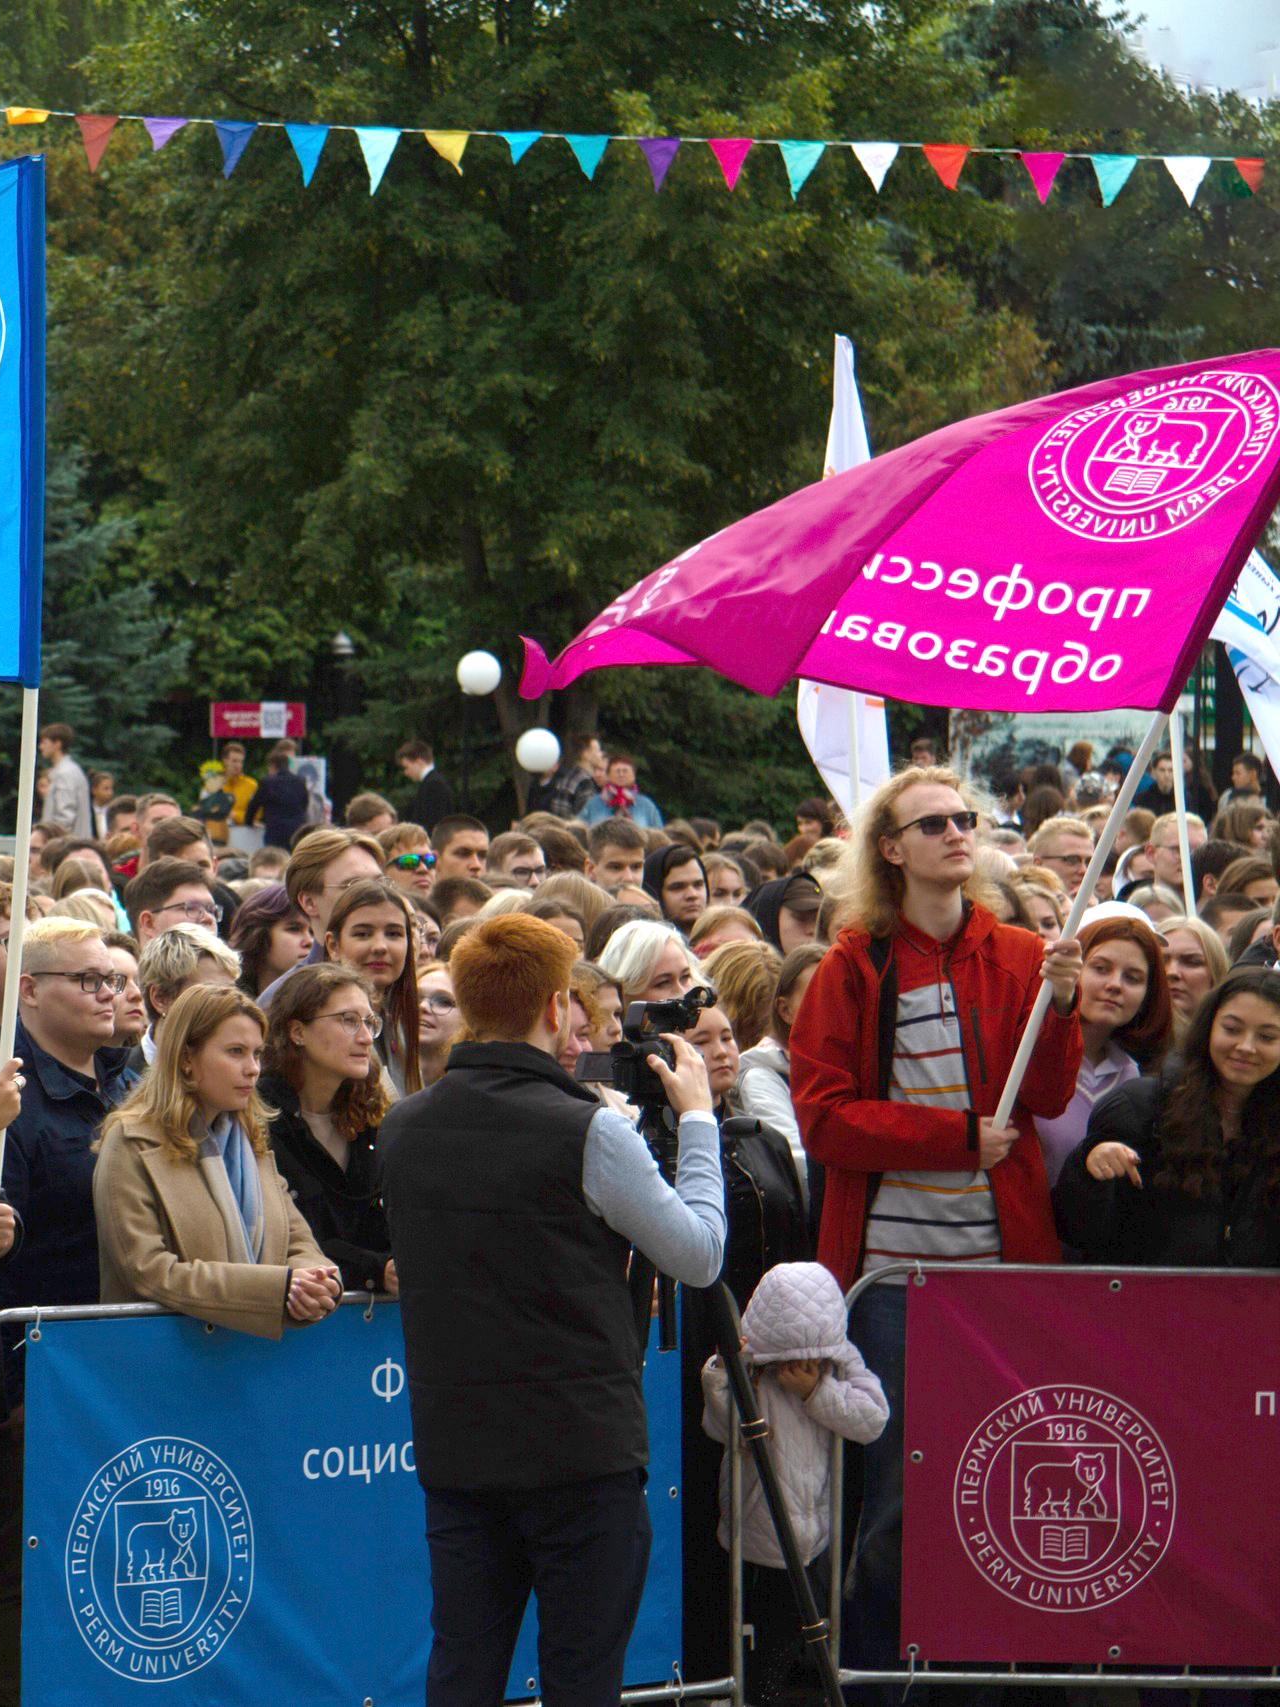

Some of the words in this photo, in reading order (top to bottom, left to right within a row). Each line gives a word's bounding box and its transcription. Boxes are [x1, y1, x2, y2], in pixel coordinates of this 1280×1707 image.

[961, 1392, 1045, 1505] ПЕРМСКИЙ
[1053, 1392, 1169, 1510] УНИВЕРСИТЕТ
[1045, 1423, 1088, 1442] 1916
[71, 1447, 145, 1575] ПЕРМСКИЙ
[150, 1444, 249, 1563] УНИВЕРСИТЕТ
[144, 1478, 181, 1498] 1916
[969, 1531, 1022, 1591] PERM
[1028, 1533, 1160, 1605] UNIVERSITY
[79, 1602, 124, 1663] PERM
[129, 1590, 243, 1674] UNIVERSITY
